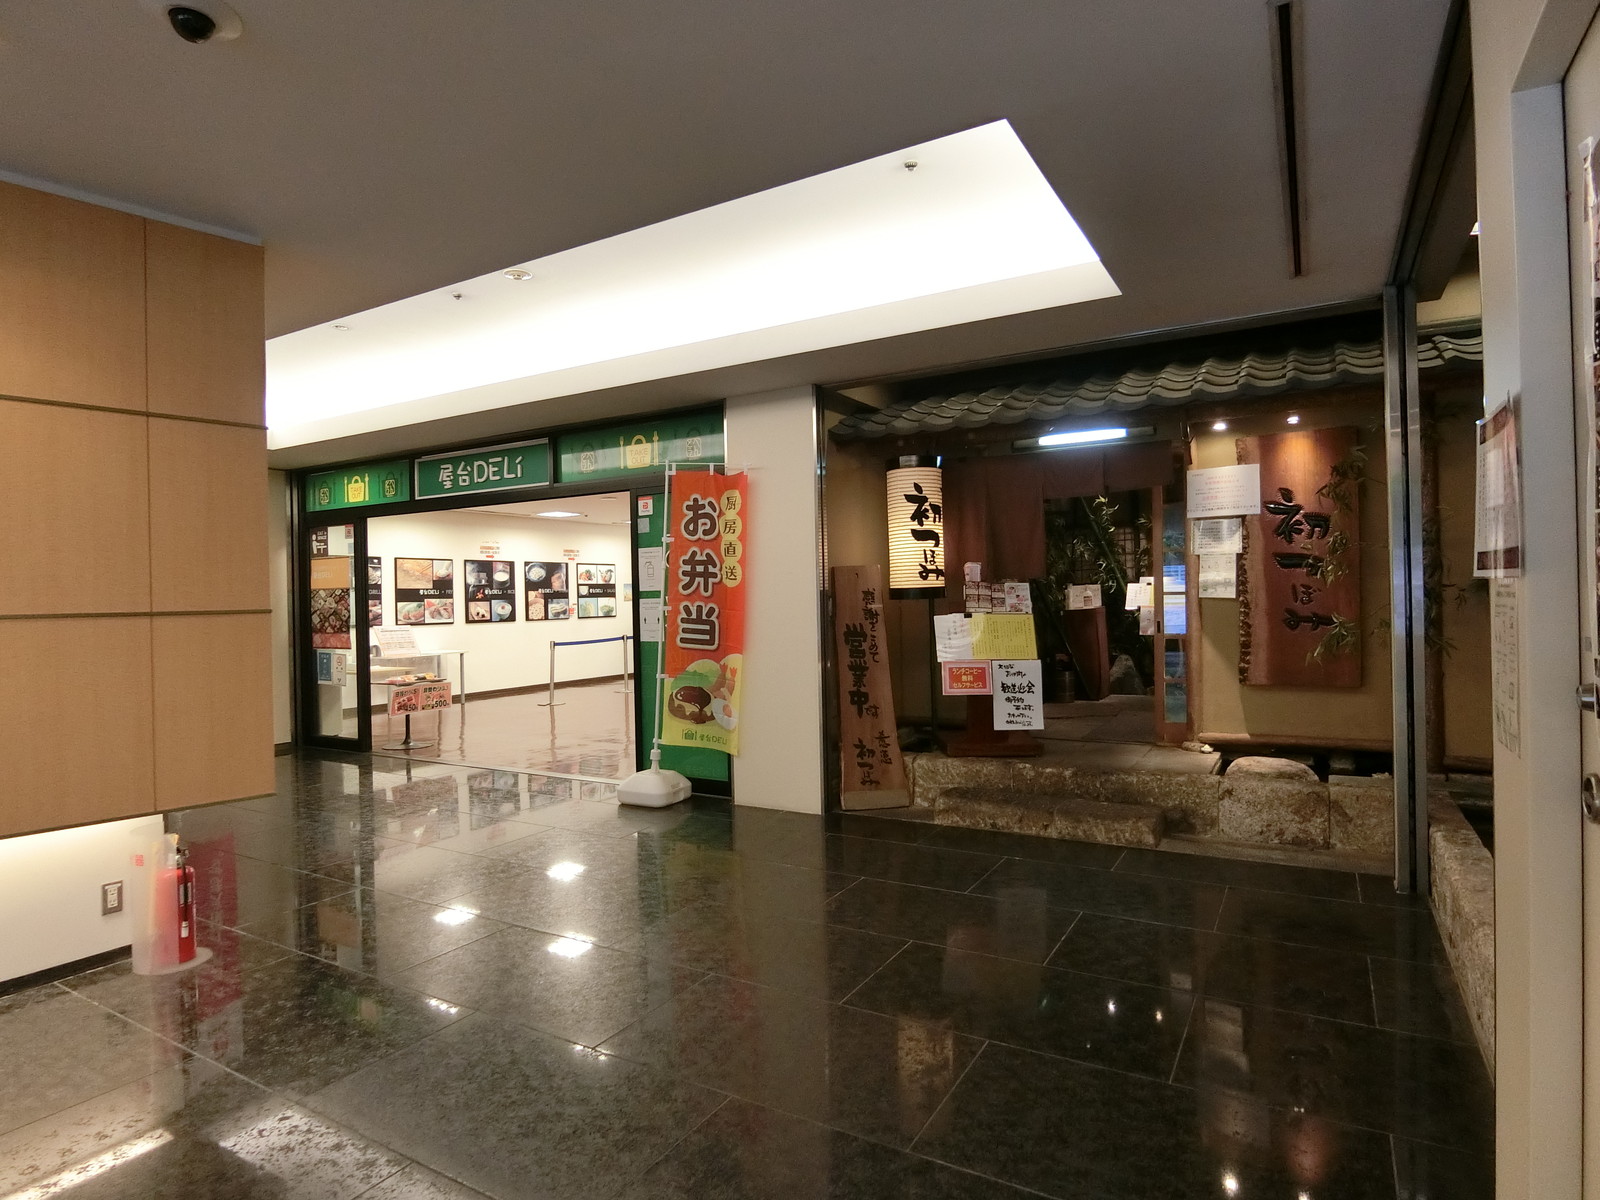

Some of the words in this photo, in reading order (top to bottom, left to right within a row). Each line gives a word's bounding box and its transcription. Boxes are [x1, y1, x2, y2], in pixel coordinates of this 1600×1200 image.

[630, 447, 649, 456] TAKE
[632, 456, 646, 465] OUT
[723, 495, 738, 581] 厨房直送
[679, 495, 719, 647] お弁当
[952, 667, 982, 675] ランチコーヒー
